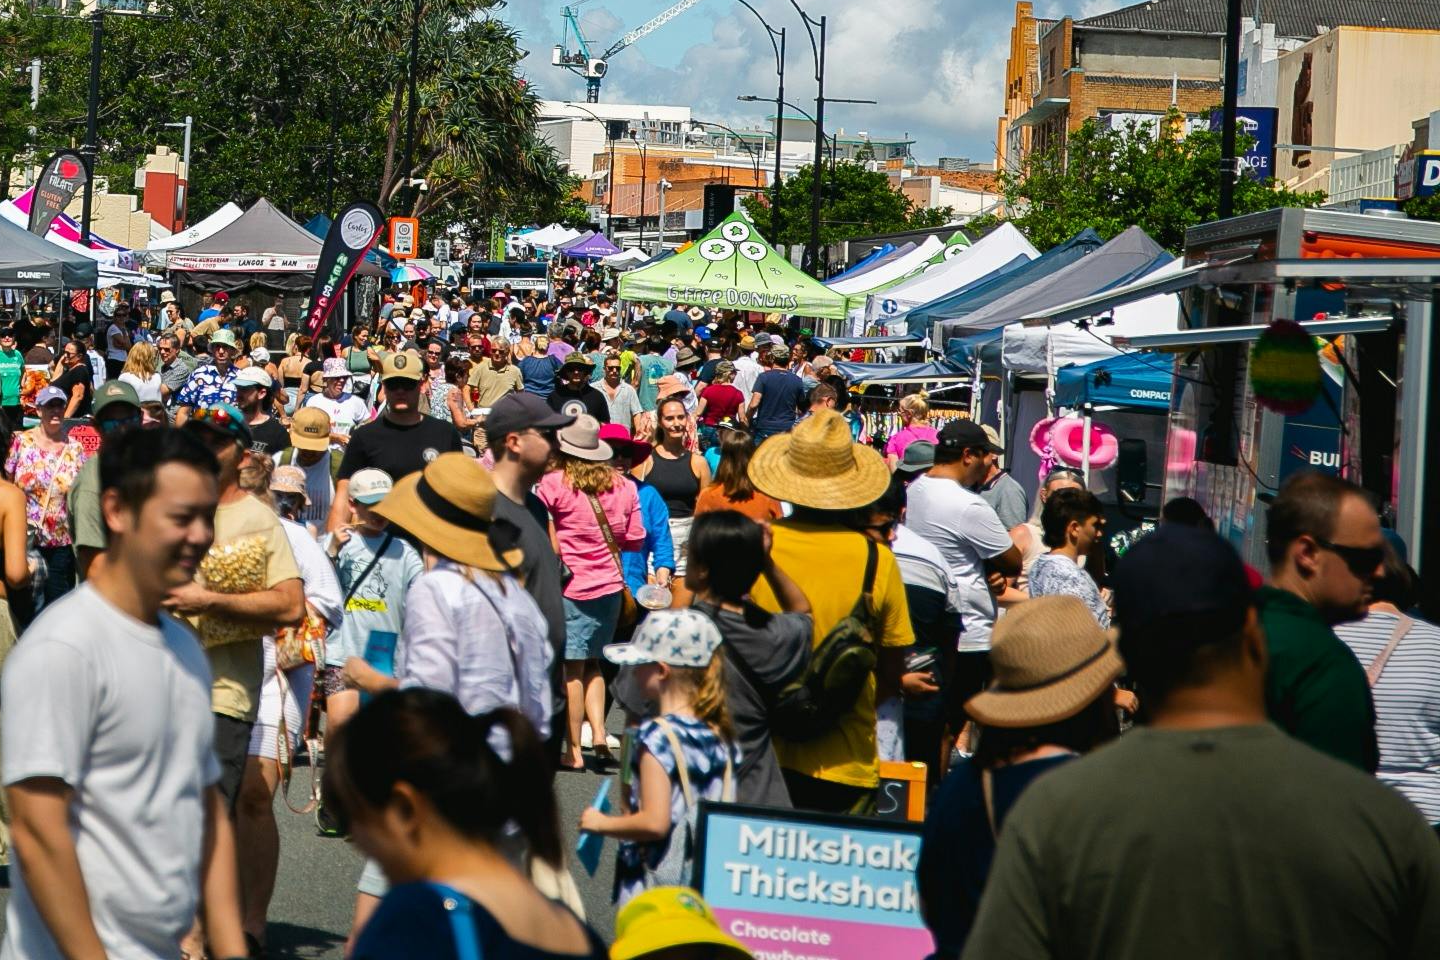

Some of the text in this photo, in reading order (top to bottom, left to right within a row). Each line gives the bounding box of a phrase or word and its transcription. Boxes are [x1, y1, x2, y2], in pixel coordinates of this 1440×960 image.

[40, 190, 64, 203] GLUTEN
[46, 199, 62, 211] FREE
[238, 259, 265, 267] LANGOS
[17, 271, 41, 279] DUNE
[309, 253, 349, 330] MEXICAN
[726, 287, 799, 312] DONUTS
[1130, 388, 1172, 401] COMPACT
[738, 823, 917, 872] Milkshak
[730, 919, 832, 946] Chocolate
